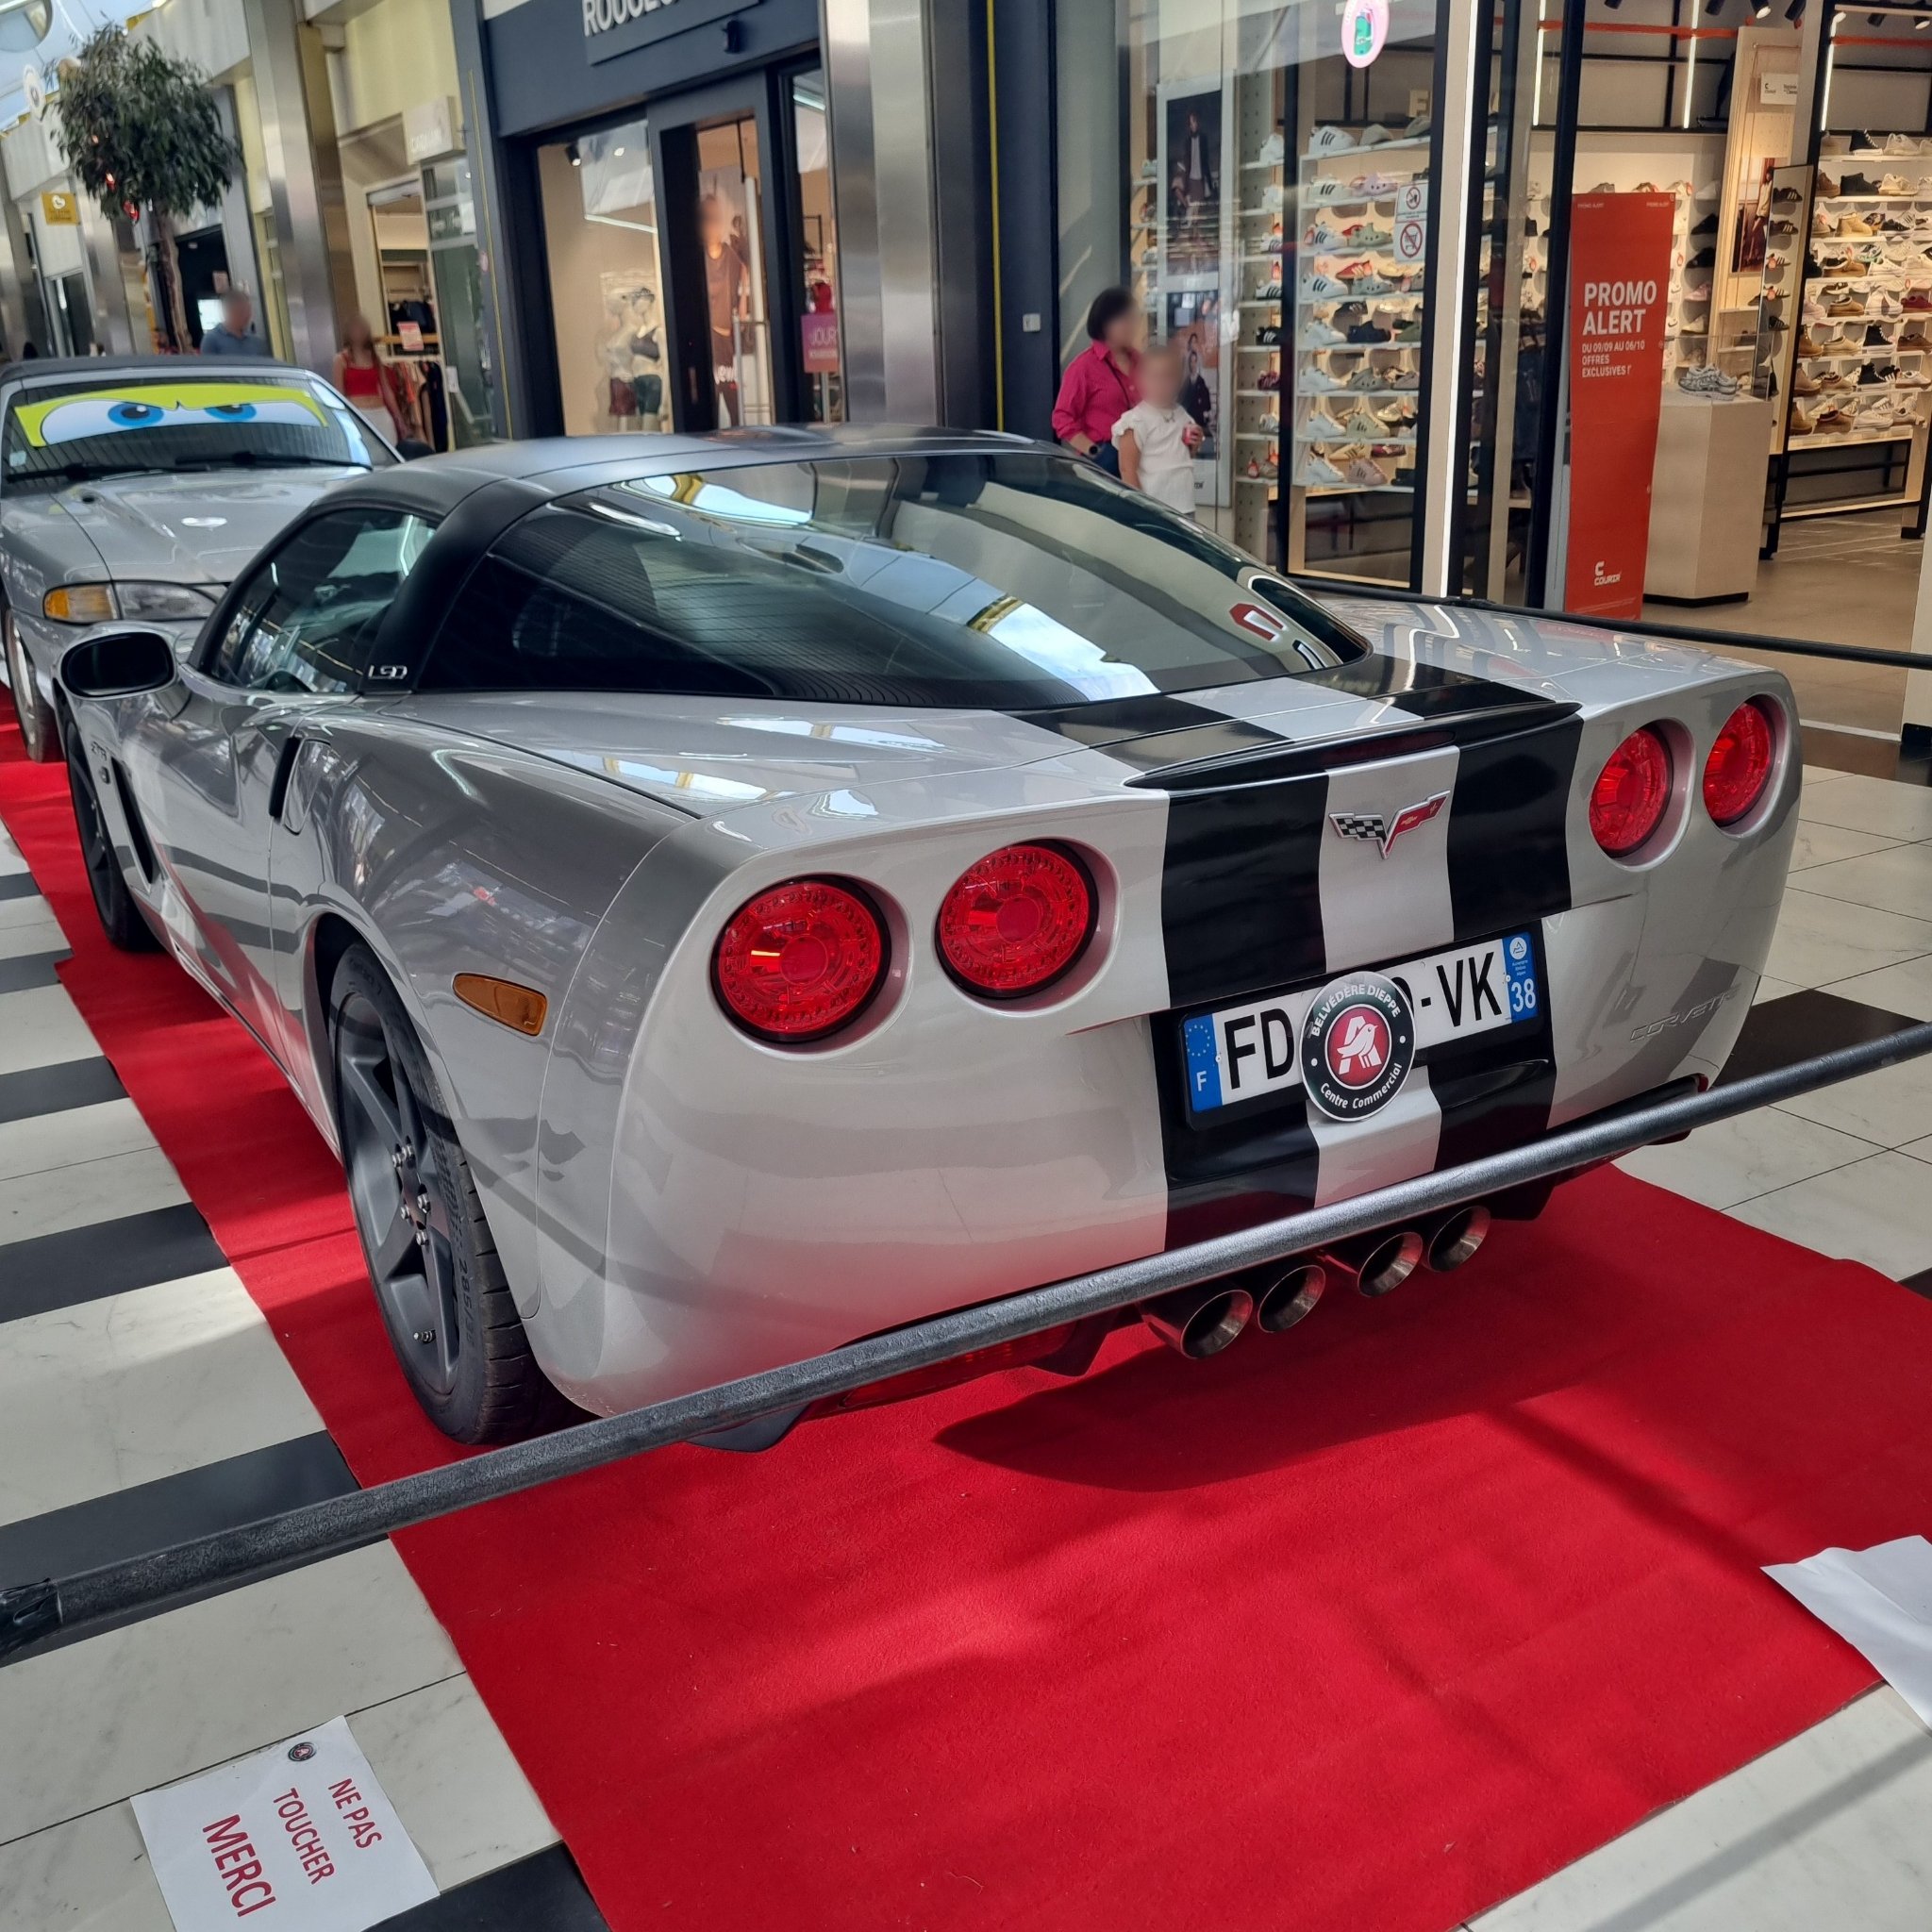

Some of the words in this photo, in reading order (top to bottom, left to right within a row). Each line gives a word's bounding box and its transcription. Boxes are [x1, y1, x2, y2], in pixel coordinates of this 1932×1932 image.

[1584, 281, 1657, 308] PROMO
[1583, 308, 1646, 336] ALERT
[1582, 343, 1591, 353] DU
[1593, 341, 1612, 353] 09/09
[1614, 341, 1624, 352] AU
[1625, 341, 1645, 351] 06/10
[1582, 355, 1609, 366] OFFRES
[1582, 366, 1625, 377] EXCLUSIVES
[1311, 984, 1366, 1037] BELVÉDÈRE
[1367, 984, 1401, 1018] DIEPPE
[1510, 978, 1536, 1012] 38
[1224, 1008, 1295, 1090] FD
[1196, 1070, 1207, 1091] F
[1321, 1082, 1349, 1108] Centre
[1352, 1062, 1403, 1109] Commercial
[327, 1777, 362, 1810] NE
[273, 1787, 336, 1885] TOUCHER
[342, 1806, 382, 1849] PAS
[202, 1813, 276, 1917] MERCI
